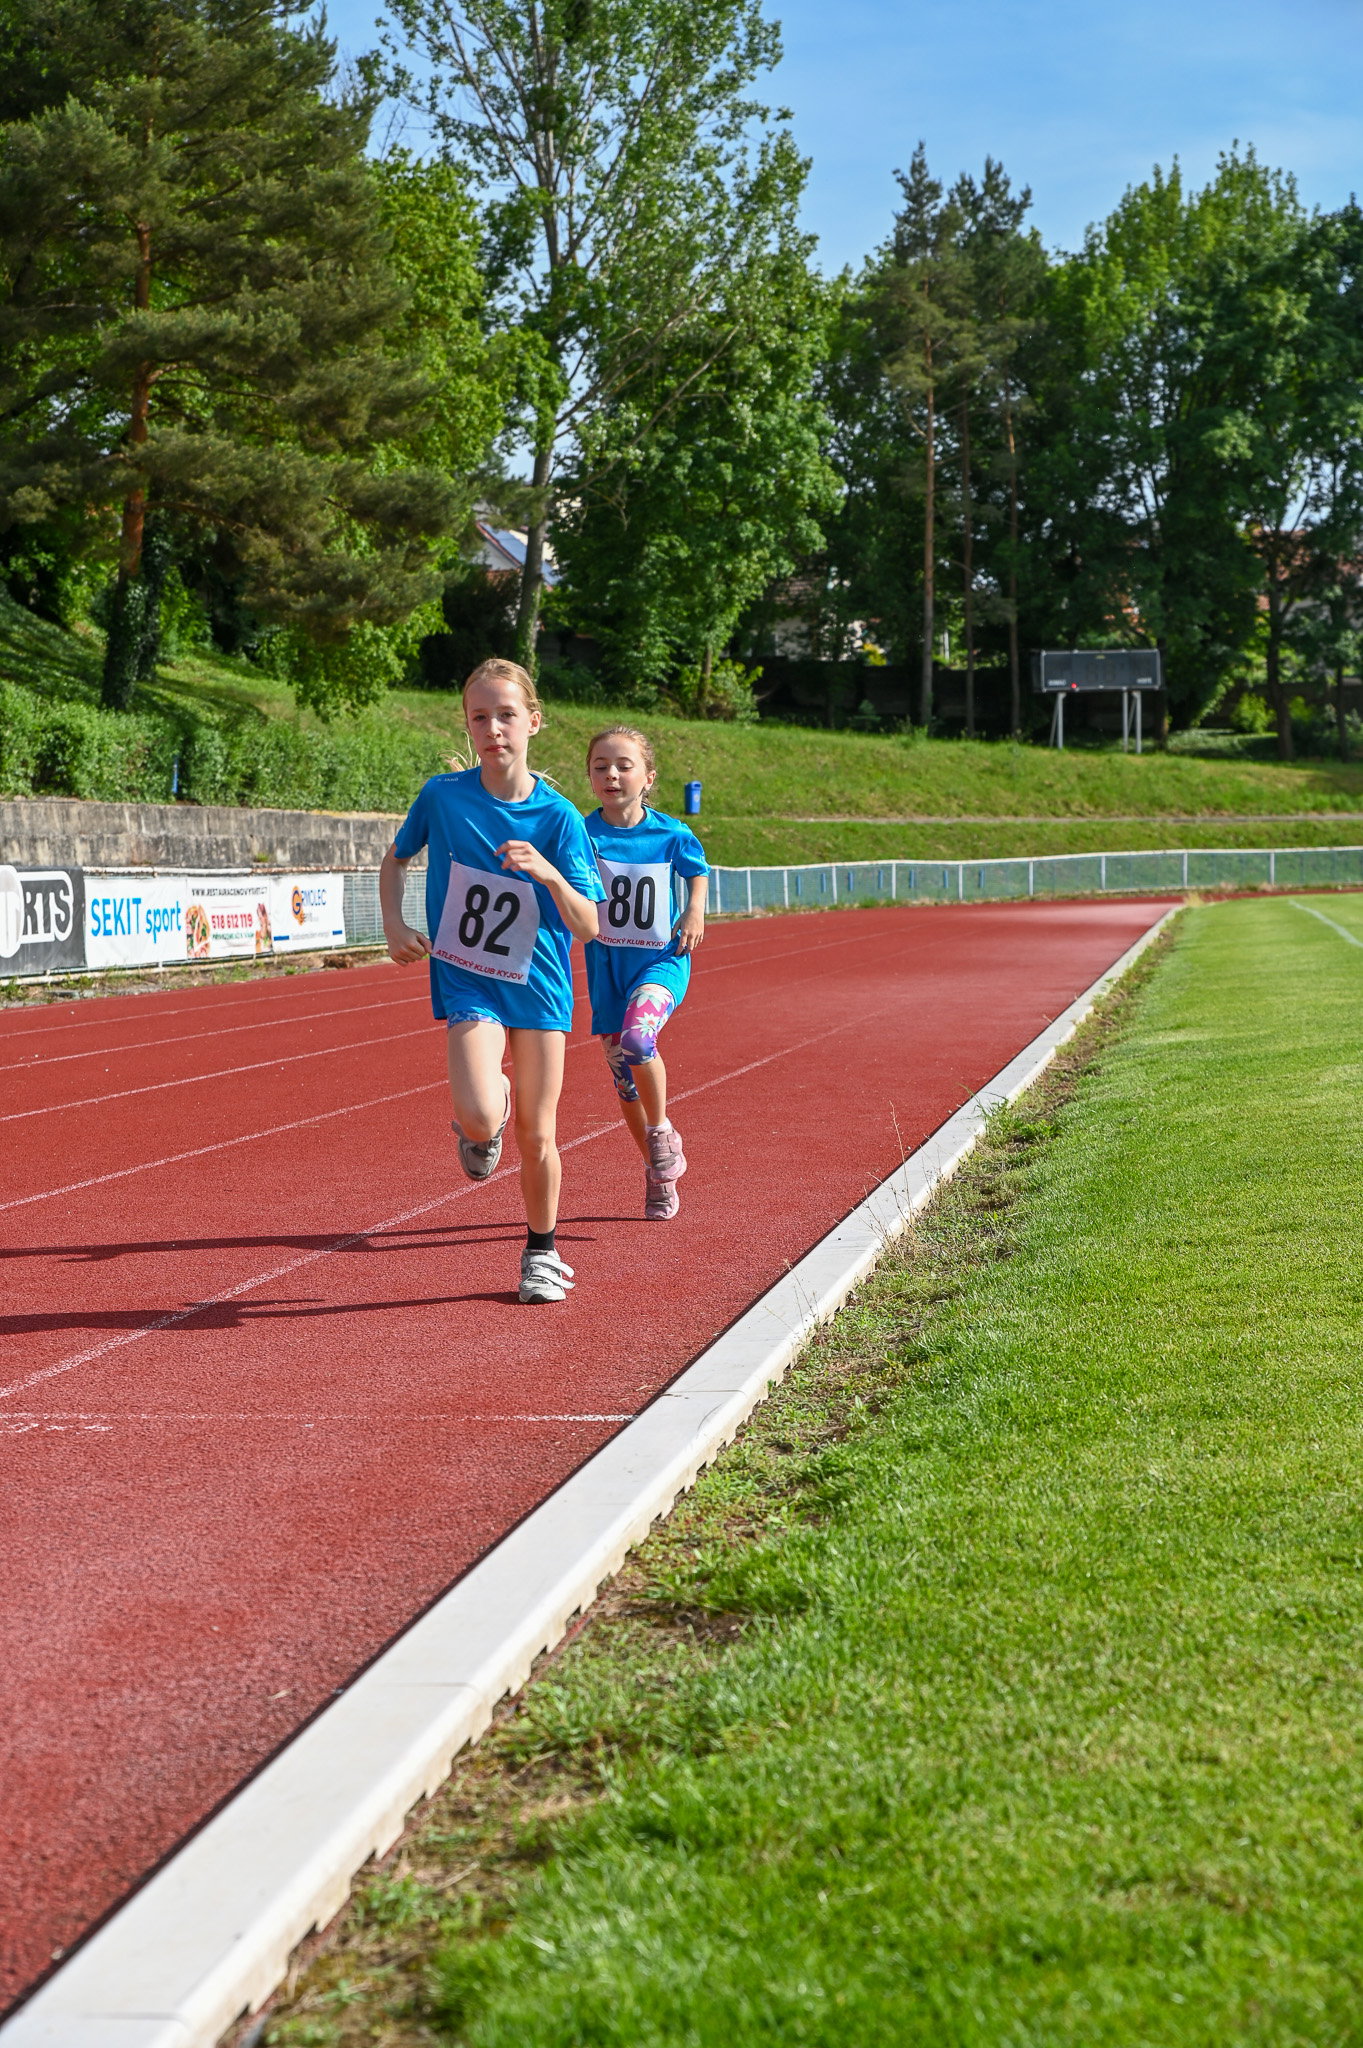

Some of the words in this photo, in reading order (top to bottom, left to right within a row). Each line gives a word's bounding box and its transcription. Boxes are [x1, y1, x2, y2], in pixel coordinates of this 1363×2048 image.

[91, 897, 142, 937] SEKIT
[145, 900, 181, 944] sport
[211, 914, 226, 929] 518
[226, 913, 239, 929] 612
[240, 913, 253, 928] 119
[458, 884, 521, 957] 82
[608, 874, 656, 930] 80
[627, 939, 645, 947] KLUB
[646, 940, 668, 948] KYJOV
[435, 949, 474, 968] ATLETICKÝ
[474, 964, 496, 976] KLUB
[497, 969, 524, 981] KYJOV
